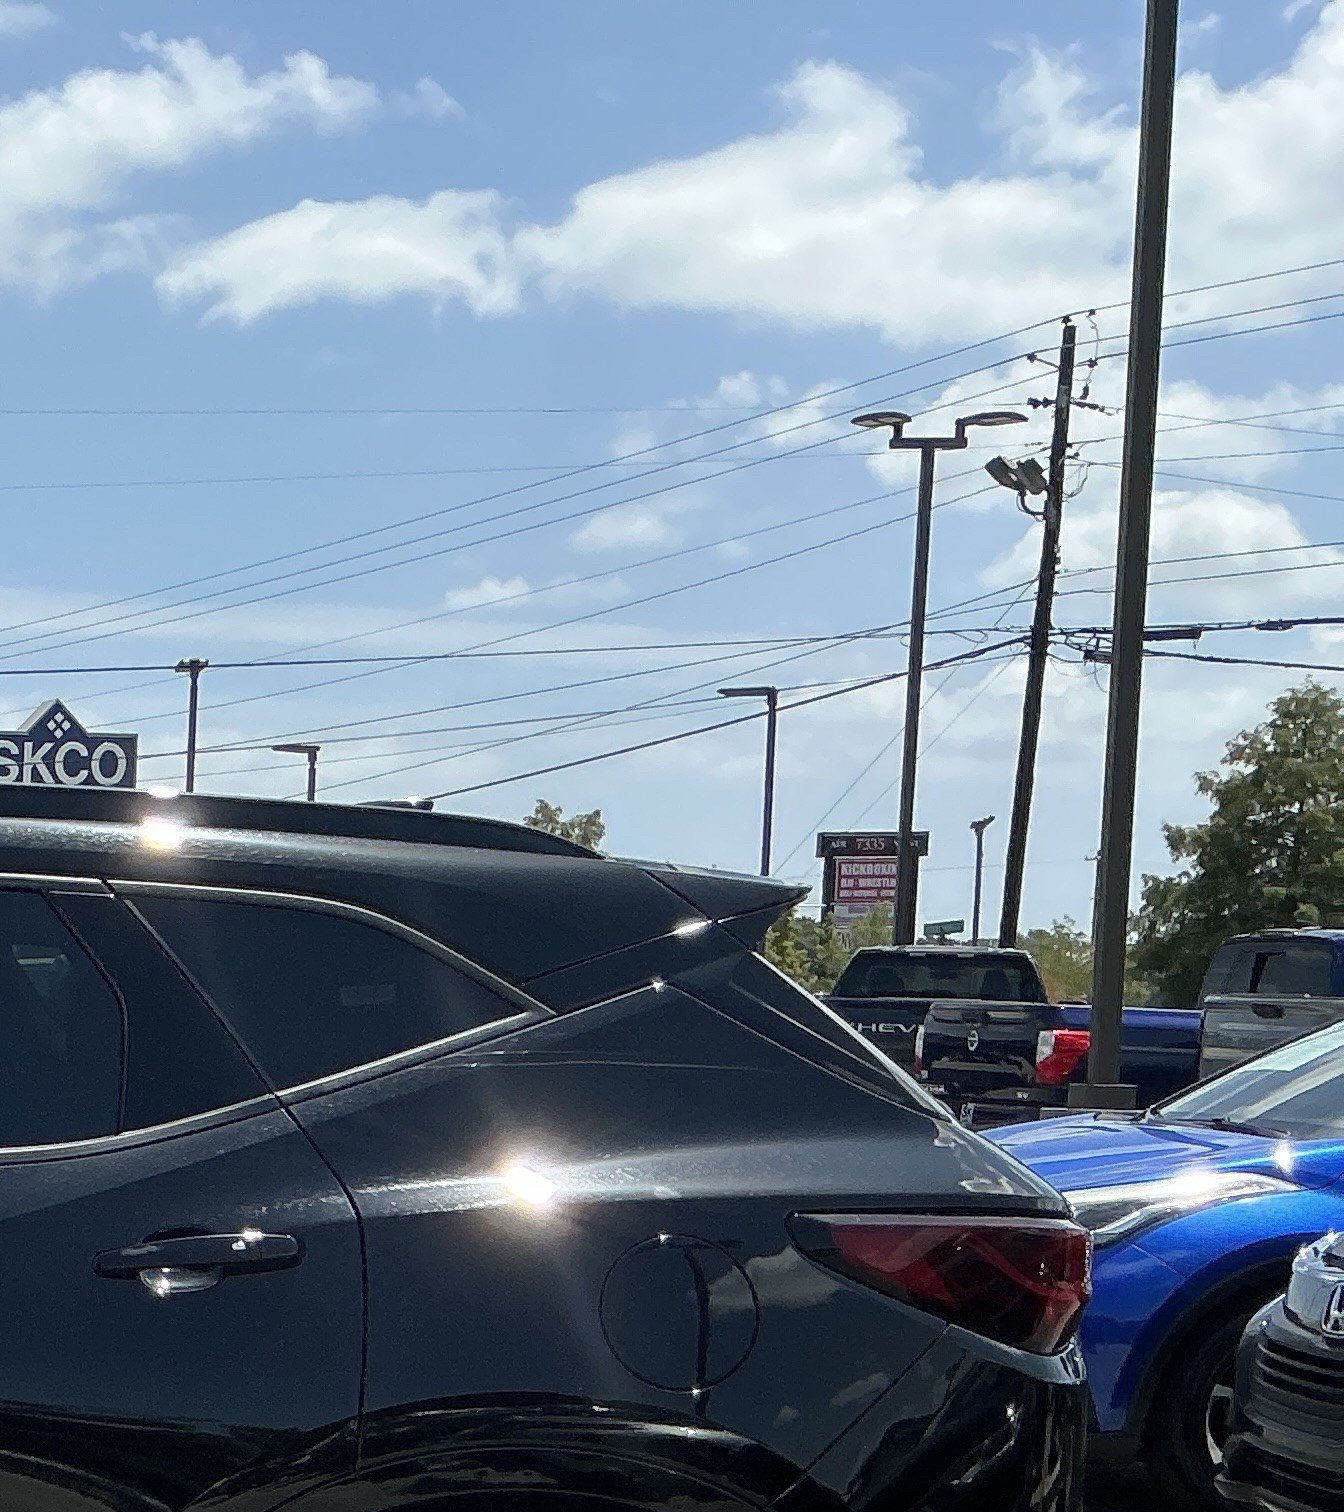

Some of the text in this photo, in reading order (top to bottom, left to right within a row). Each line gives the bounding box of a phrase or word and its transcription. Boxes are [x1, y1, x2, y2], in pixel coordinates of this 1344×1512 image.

[855, 838, 885, 850] 7335
[841, 863, 897, 876] KICKBOXIN
[849, 1022, 917, 1033] HEV
